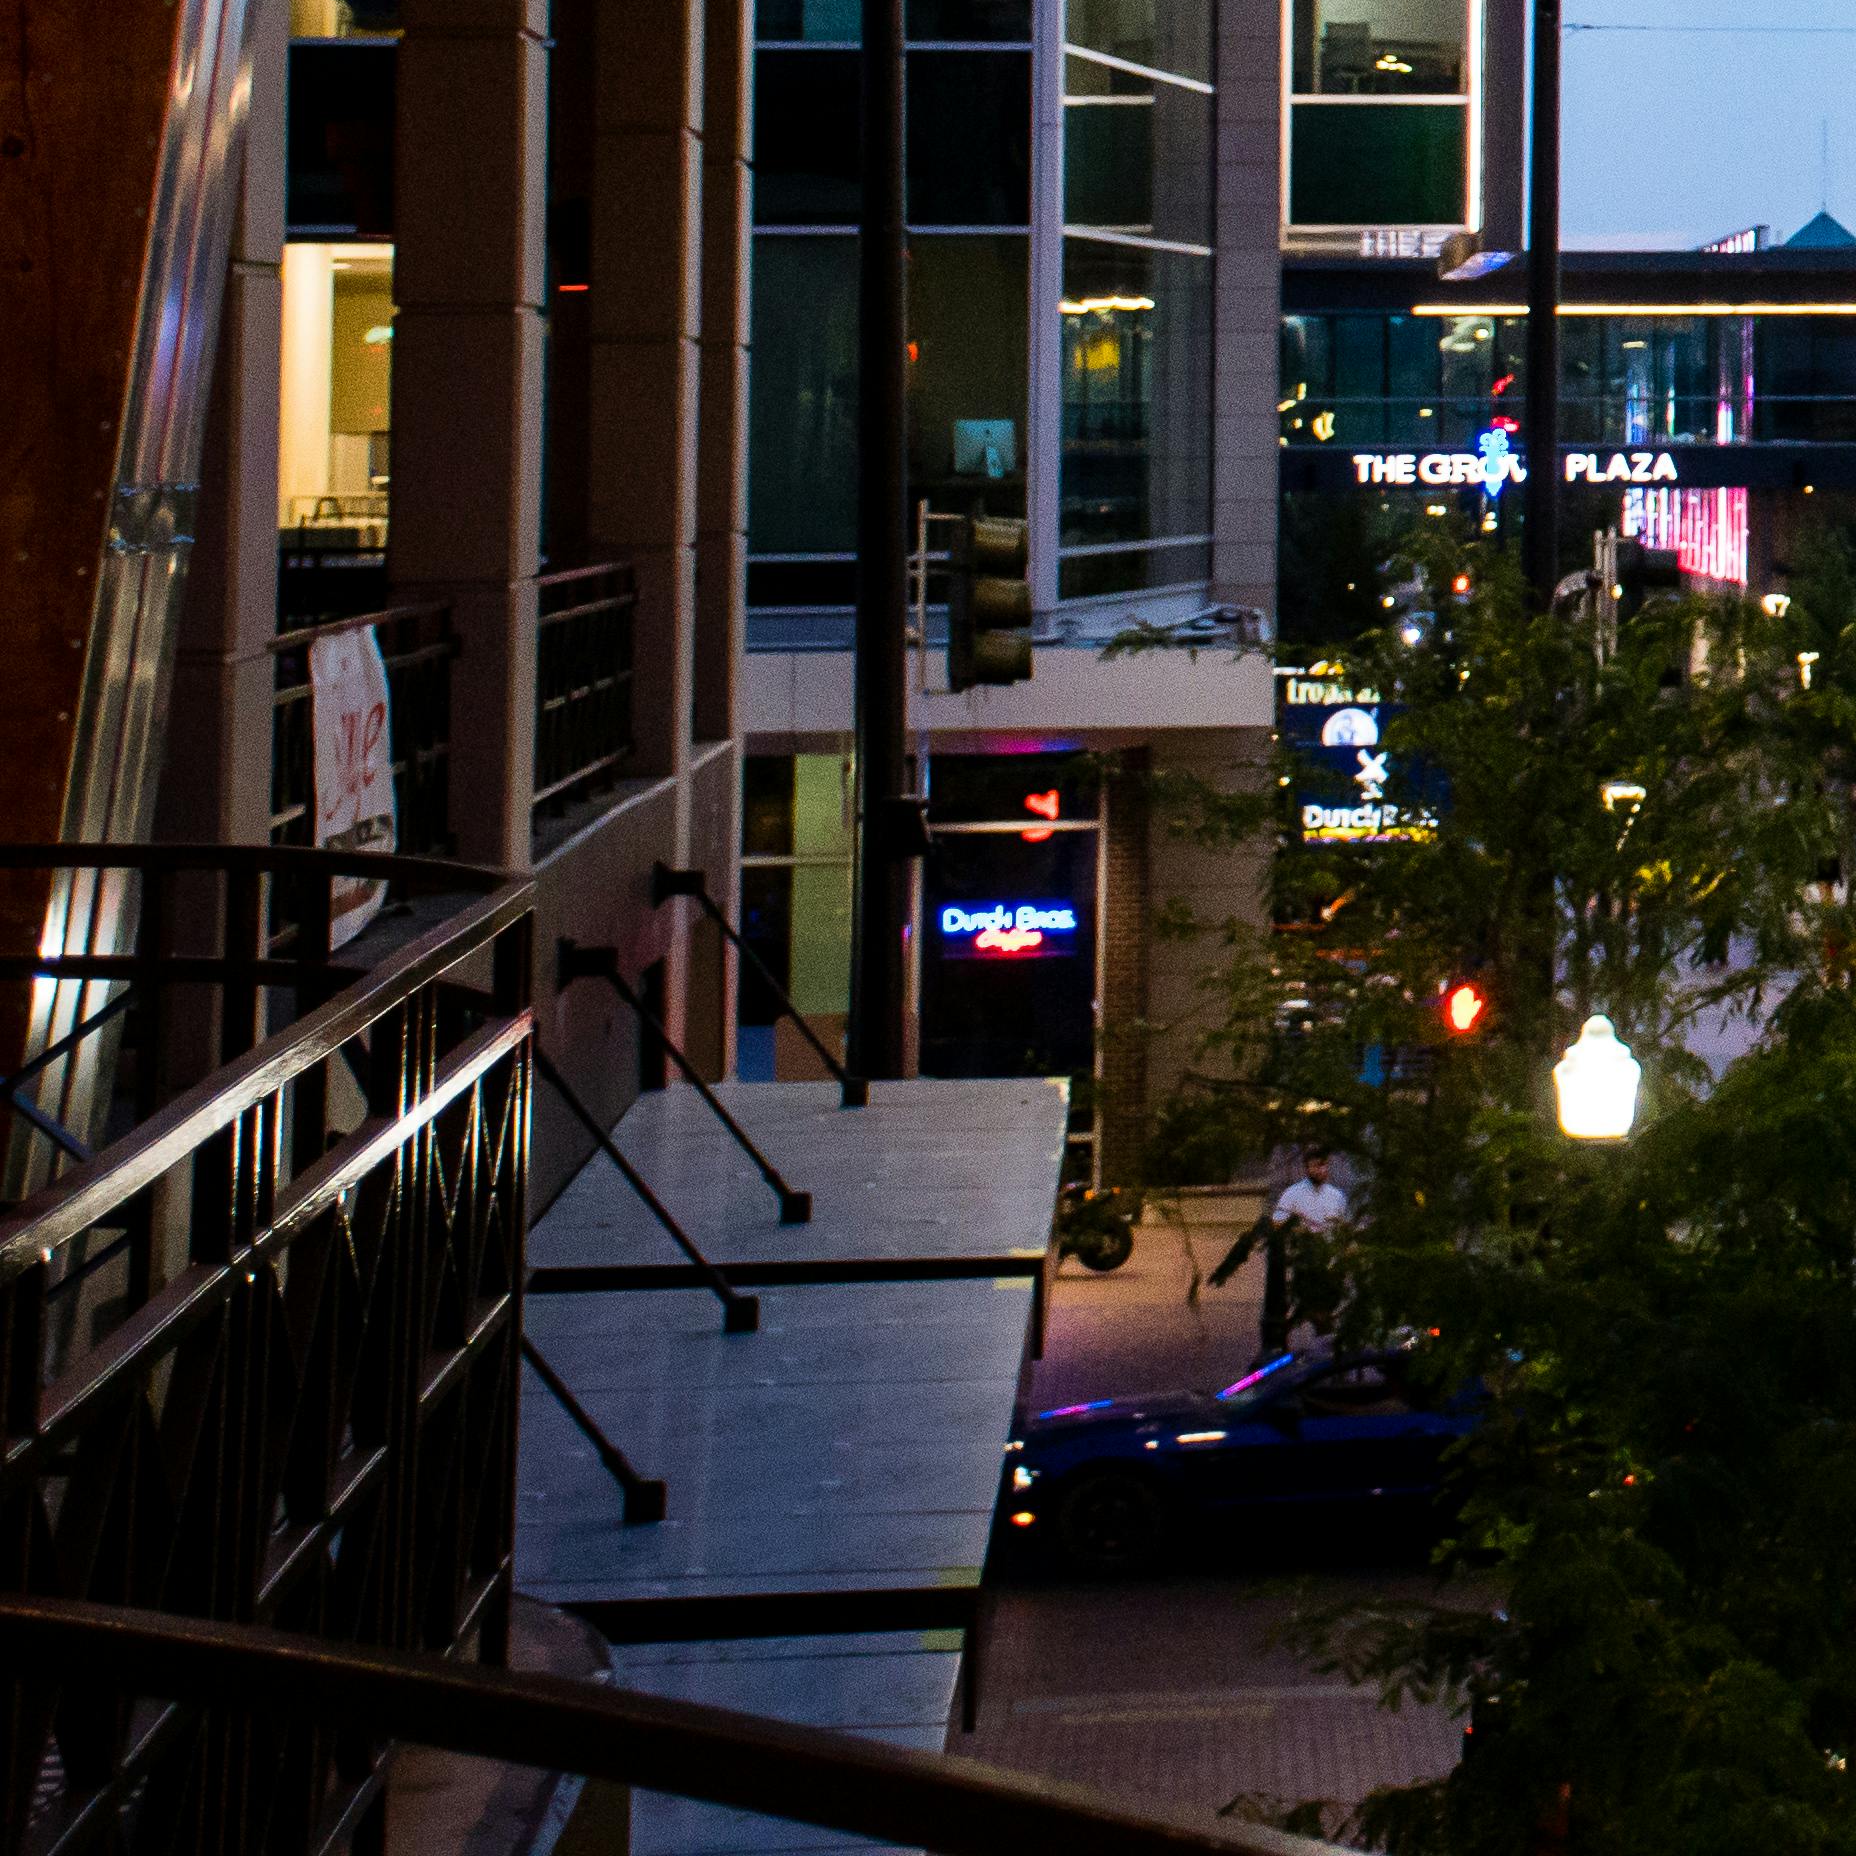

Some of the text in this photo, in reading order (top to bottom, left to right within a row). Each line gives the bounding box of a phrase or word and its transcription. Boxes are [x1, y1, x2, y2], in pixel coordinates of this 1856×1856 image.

[1353, 454, 1416, 484] THE
[1565, 453, 1678, 483] PLAZA
[942, 904, 1013, 932] Dutch
